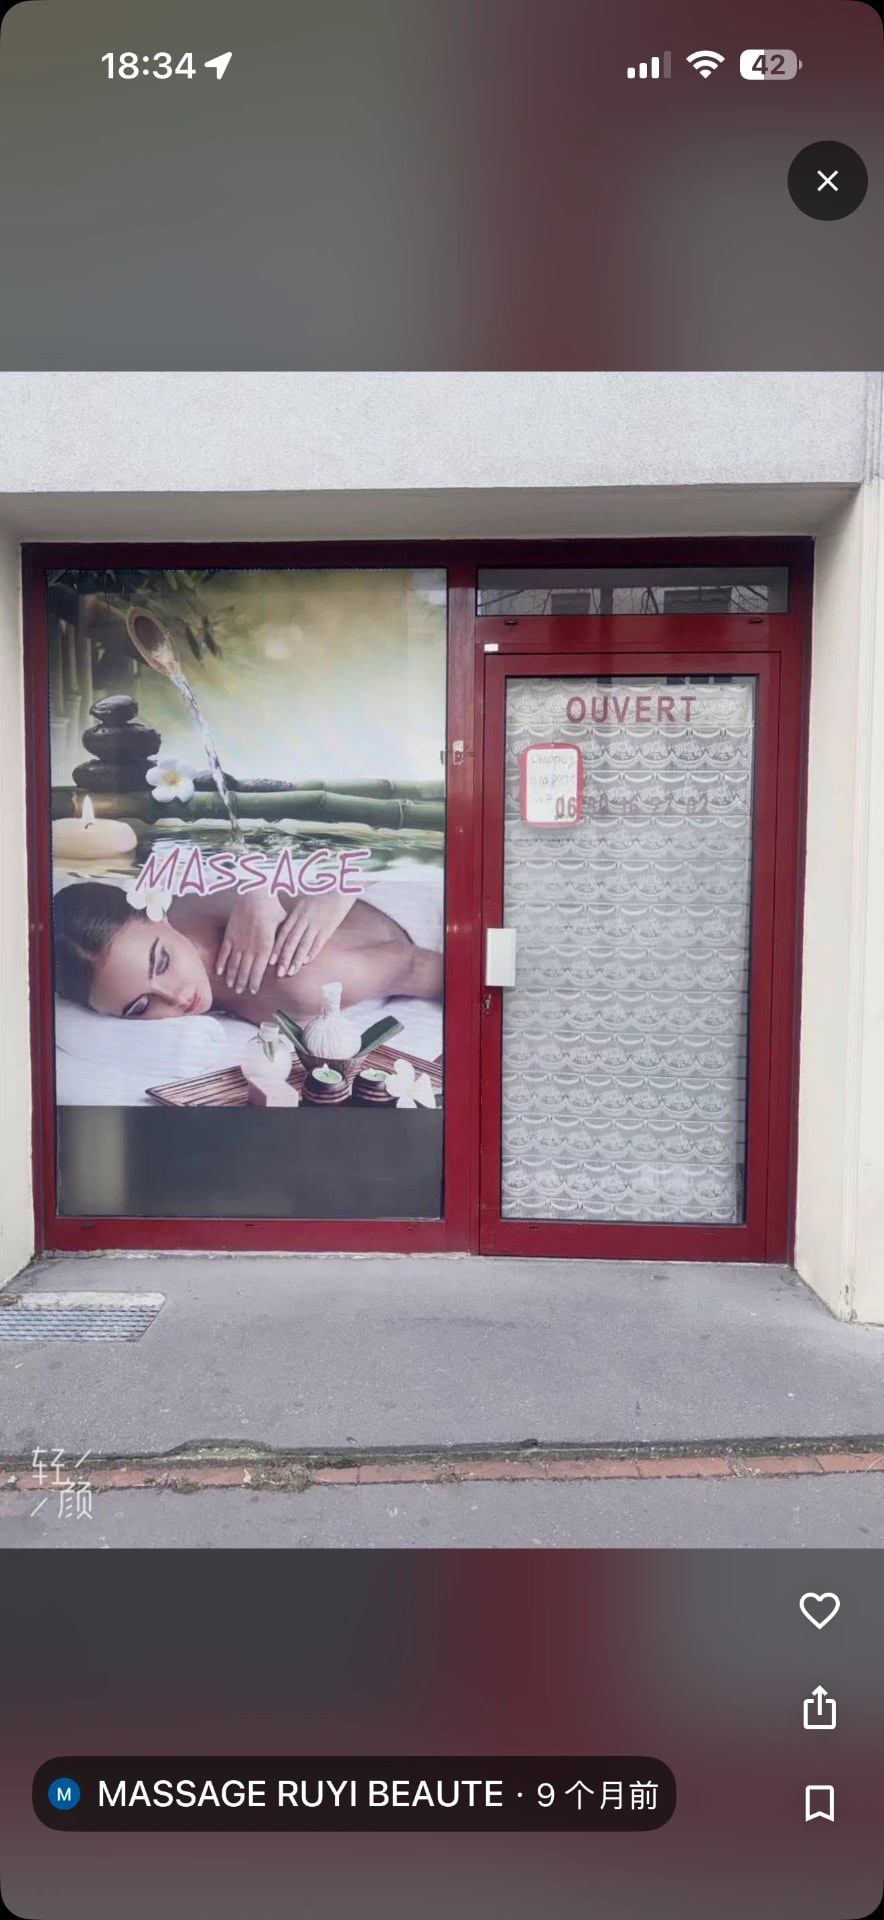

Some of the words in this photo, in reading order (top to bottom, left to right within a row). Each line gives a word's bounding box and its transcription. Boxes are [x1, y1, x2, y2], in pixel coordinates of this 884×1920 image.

[566, 695, 697, 724] OUVERT
[555, 796, 578, 819] 06
[135, 847, 372, 896] MASSAGE
